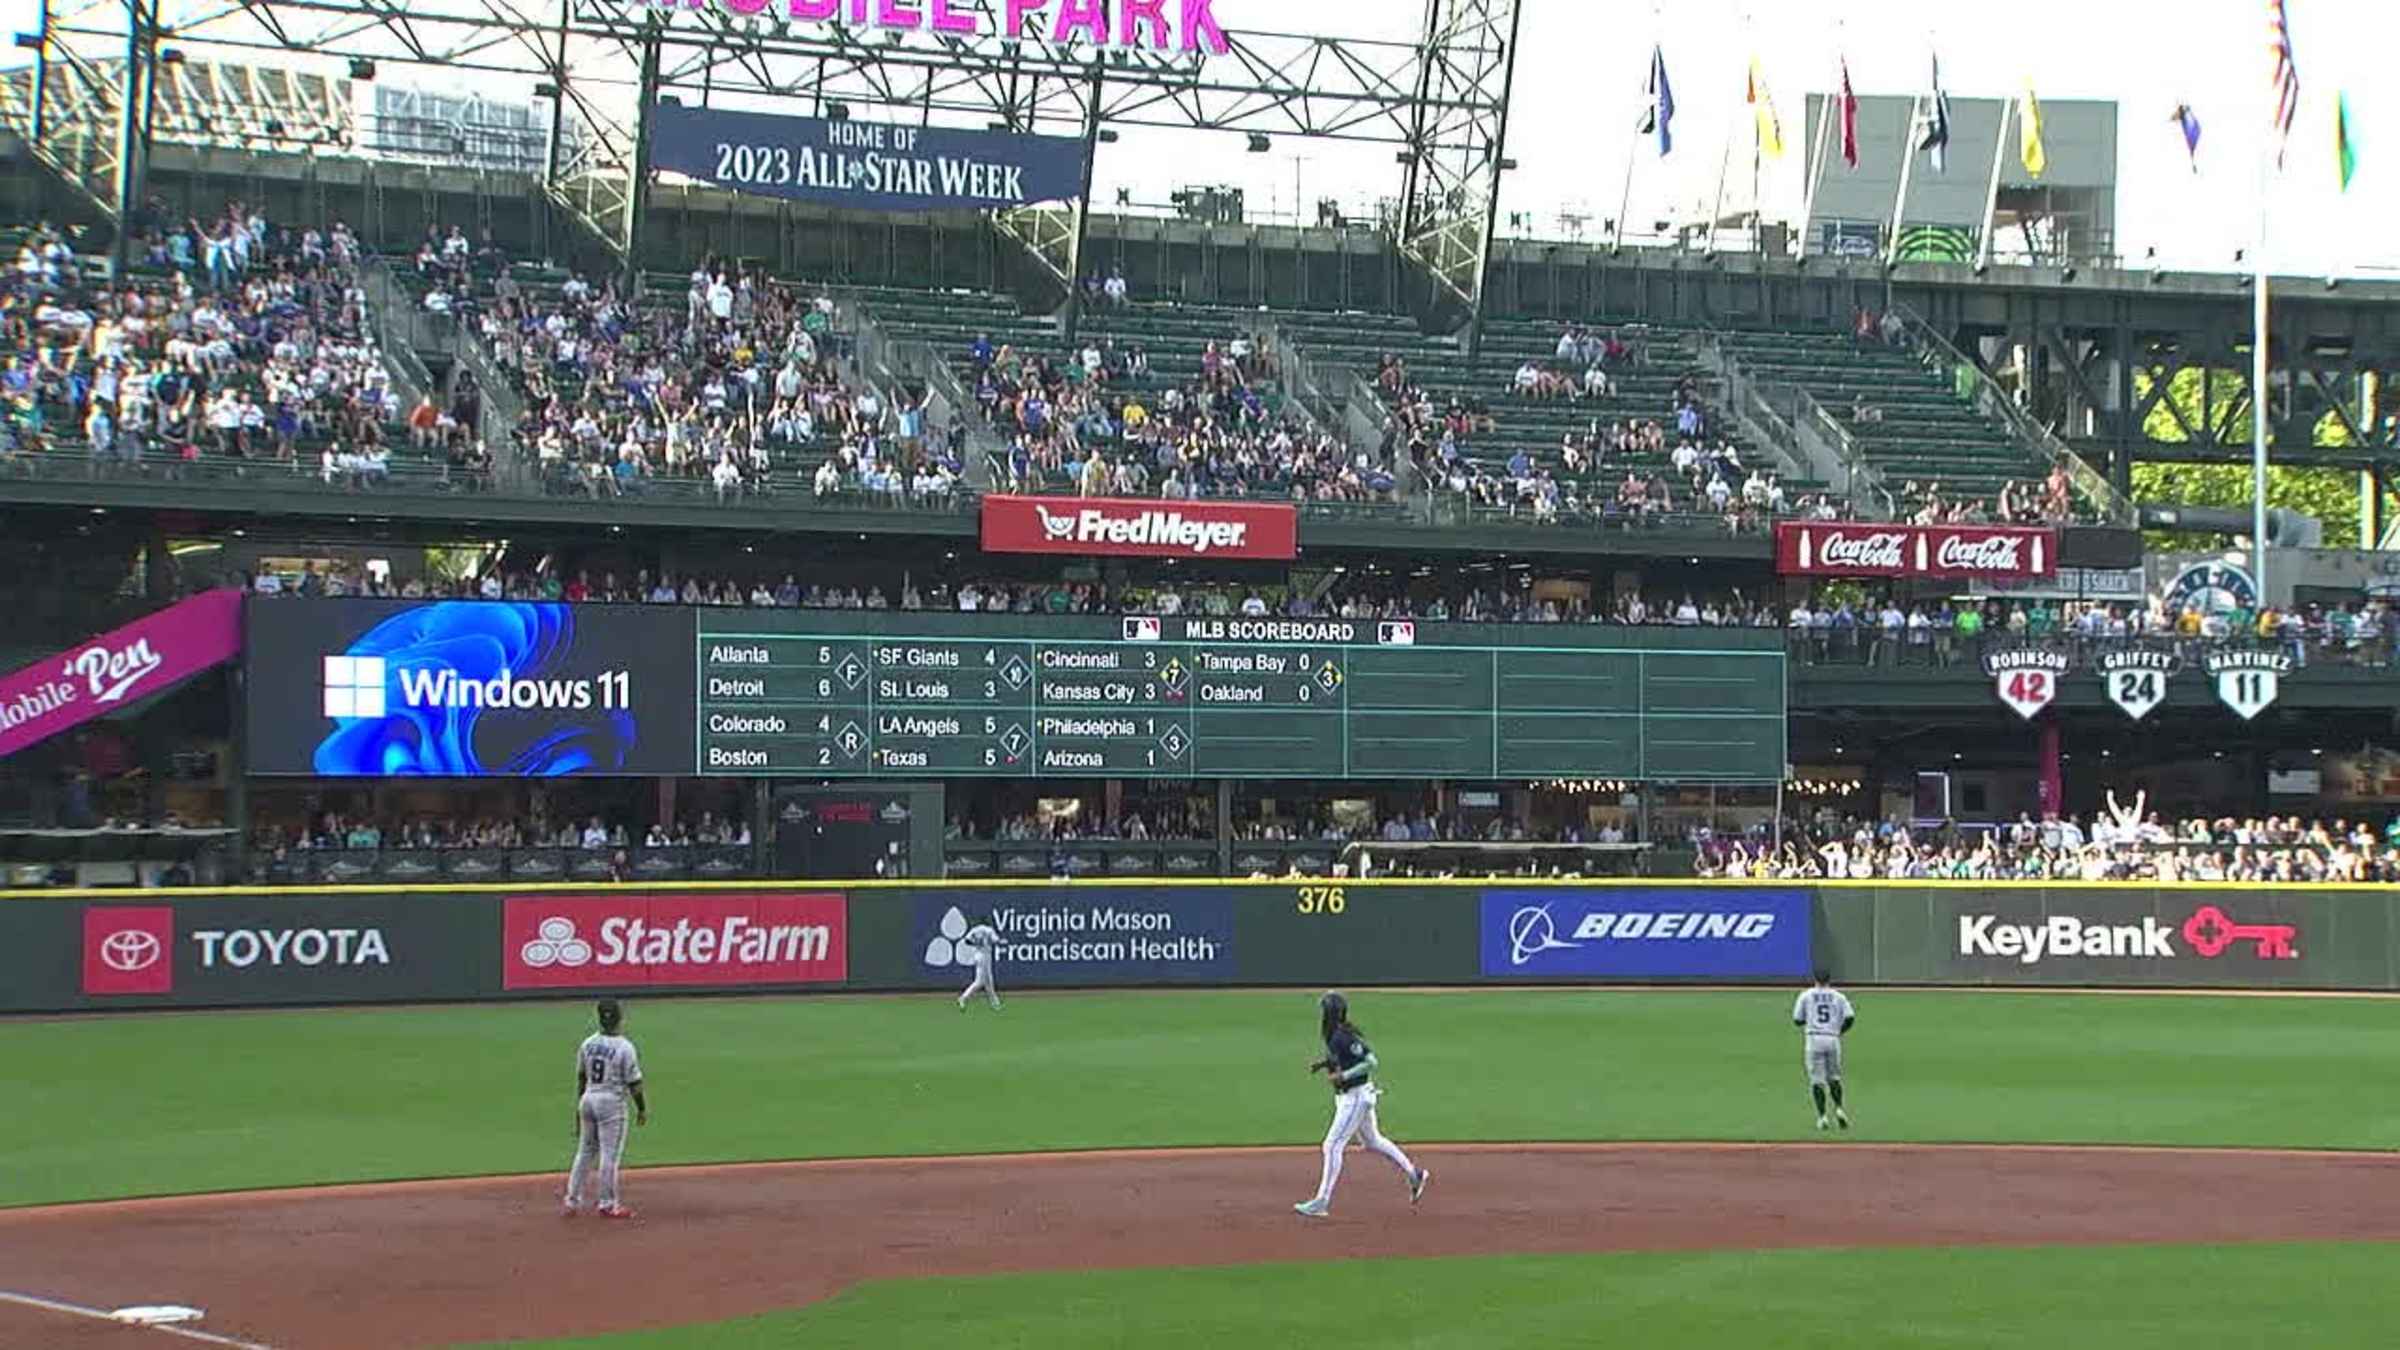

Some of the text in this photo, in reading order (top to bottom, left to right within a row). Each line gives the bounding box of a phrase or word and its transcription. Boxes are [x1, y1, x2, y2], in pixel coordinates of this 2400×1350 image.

[829, 123, 916, 150] HOME OF
[717, 144, 790, 183] 2023
[938, 157, 1023, 200] WEEK
[1187, 622, 1353, 640] MLB SCOREBOARD
[711, 646, 830, 663] Atlanta 5
[880, 648, 994, 665] SF Giants 4
[1044, 651, 1155, 667] Cincinnati 3
[1202, 653, 1309, 673] Tampa Bay 0
[1990, 650, 2067, 668] ROBINSON
[2105, 650, 2171, 667] GRIFFEY
[2209, 650, 2291, 670] MARTINEZ
[846, 666, 857, 680] F
[1170, 668, 1179, 683] 7
[1323, 670, 1334, 687] 3
[400, 668, 629, 709] Windows 11
[710, 679, 830, 696] Detroit 6
[907, 682, 949, 697] Louis
[986, 681, 995, 697] 3
[1044, 683, 1155, 703] Kansas City 3
[1202, 685, 1309, 701] Oakland 0
[2009, 673, 2046, 701] 42
[2120, 674, 2155, 702] 24
[2235, 674, 2262, 702] 11
[710, 715, 829, 731] Colorado 4
[880, 717, 995, 737] LA Angels 5
[1044, 718, 1153, 738] Philadelphia 1
[846, 733, 857, 748] R
[1010, 734, 1020, 749] 7
[1169, 737, 1179, 751] 3
[710, 748, 829, 765] Boston 2
[881, 749, 995, 765] Texas 5
[1044, 750, 1153, 766] Arizona 1
[1299, 887, 1345, 914] 376
[993, 908, 1170, 938] Virginia Mason
[1573, 914, 1774, 938] BOEING
[193, 929, 389, 966] TOYOTA
[1960, 916, 2175, 963] KeyBank
[995, 938, 1214, 961] Franciscan Health
[1817, 1004, 1830, 1023] 5
[592, 1058, 604, 1084] 9
